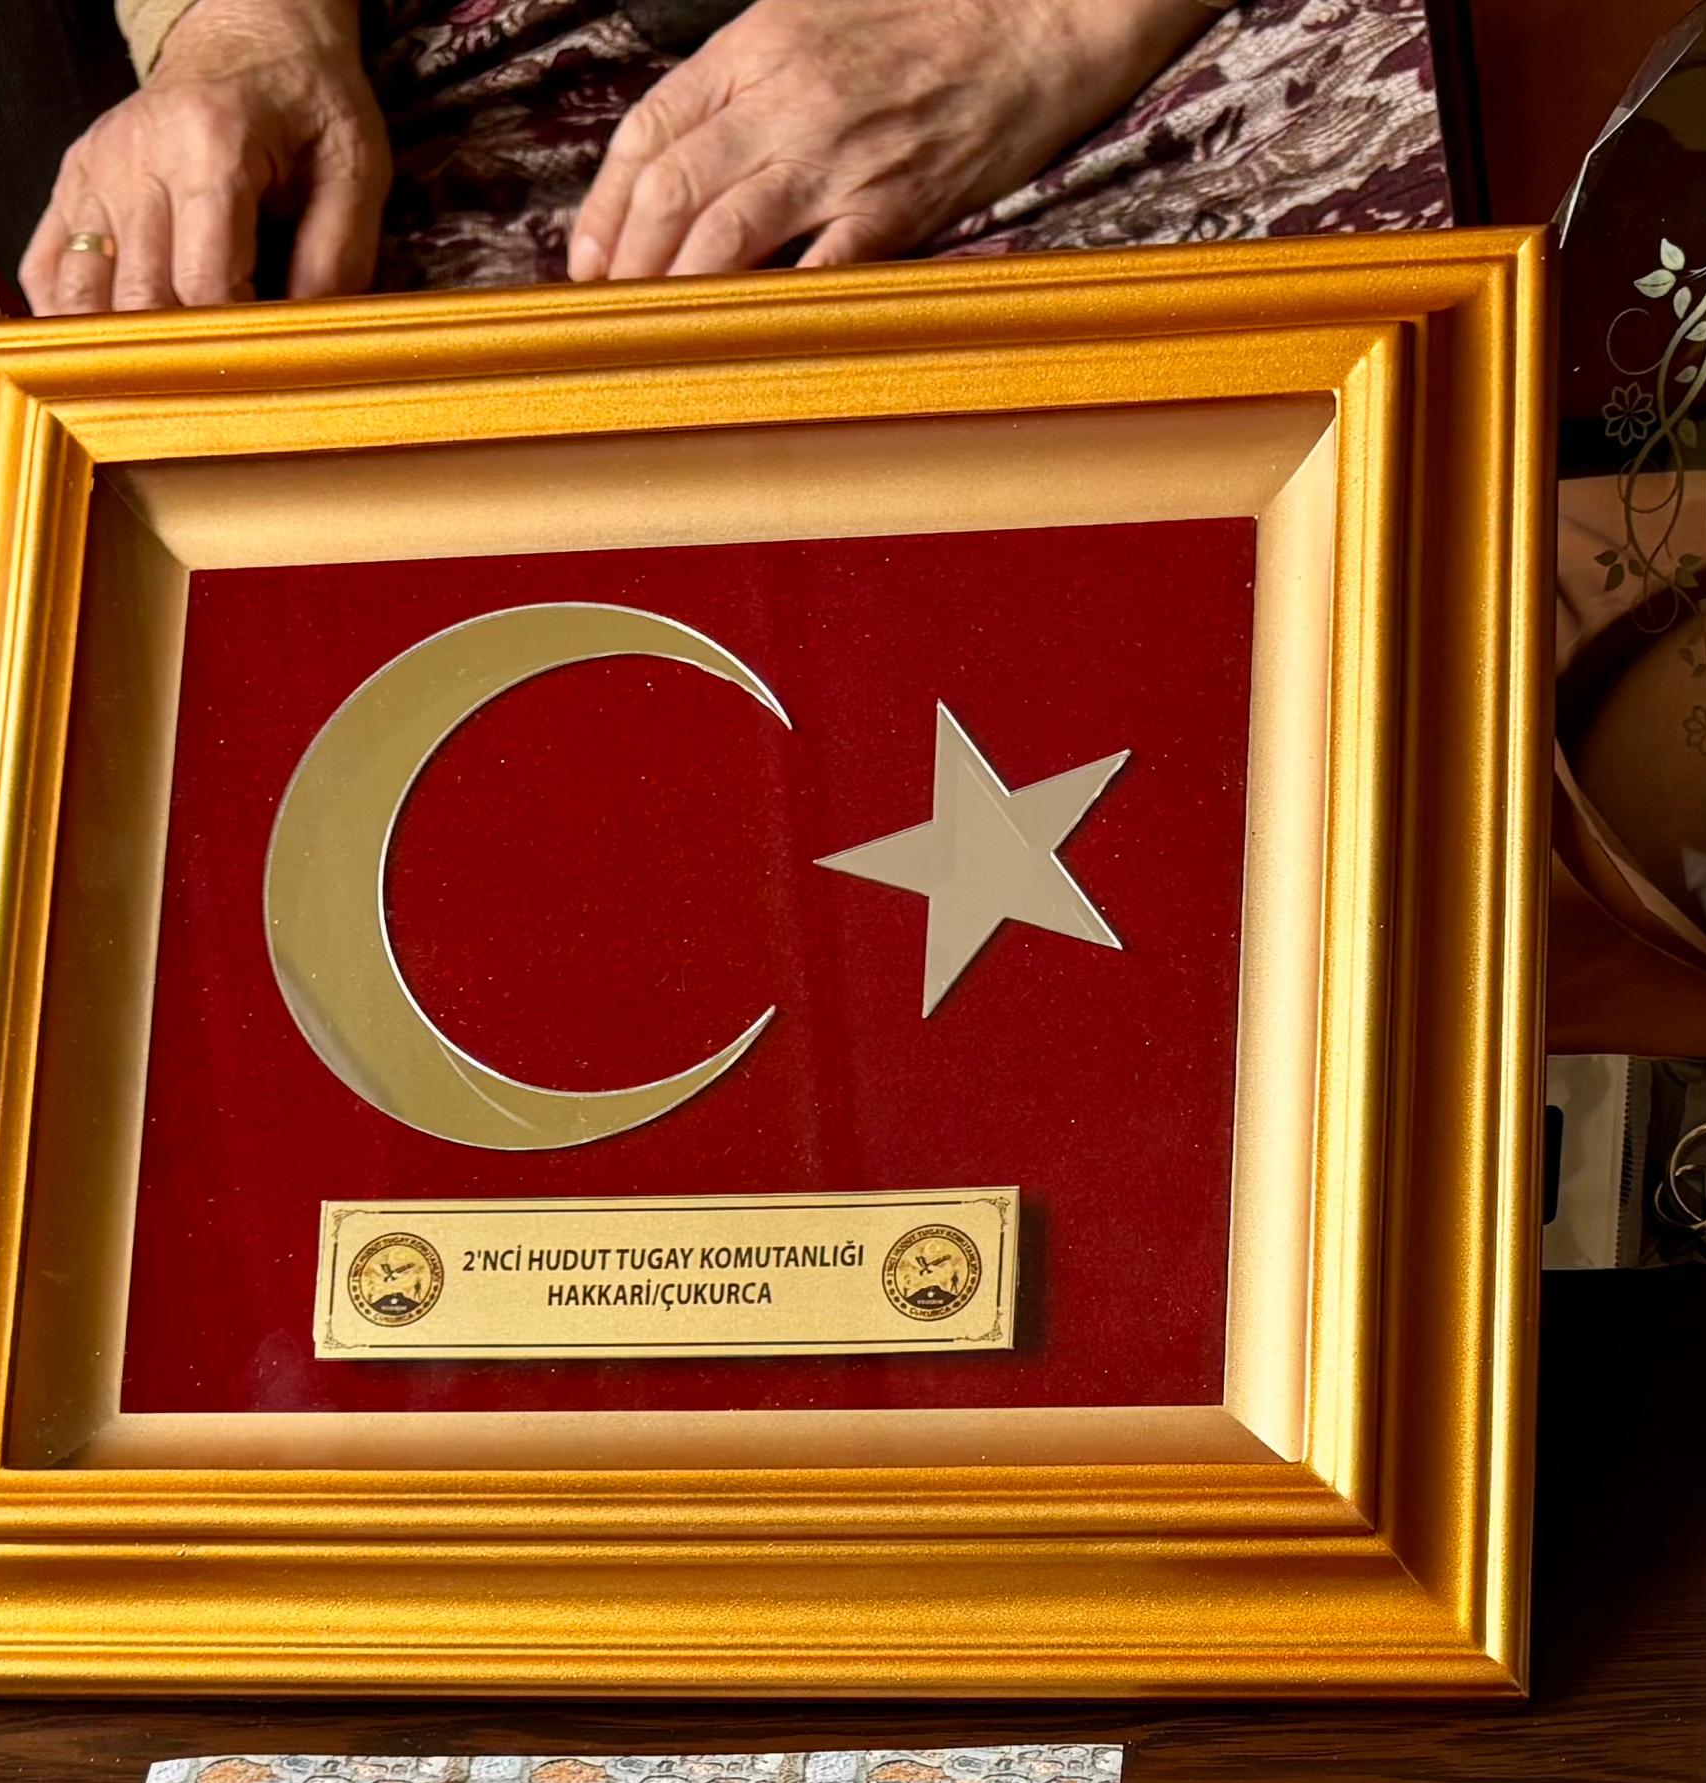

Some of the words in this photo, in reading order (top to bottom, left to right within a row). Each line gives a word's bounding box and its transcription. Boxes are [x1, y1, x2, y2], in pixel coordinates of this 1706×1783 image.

[462, 1244, 522, 1272] 2'NCİ
[528, 1248, 611, 1271] HUDUT
[616, 1247, 694, 1271] TUGAY
[700, 1240, 864, 1269] KOMUTANLIĞI
[547, 1278, 773, 1312] HAKKARİ/ÇUKURCA
